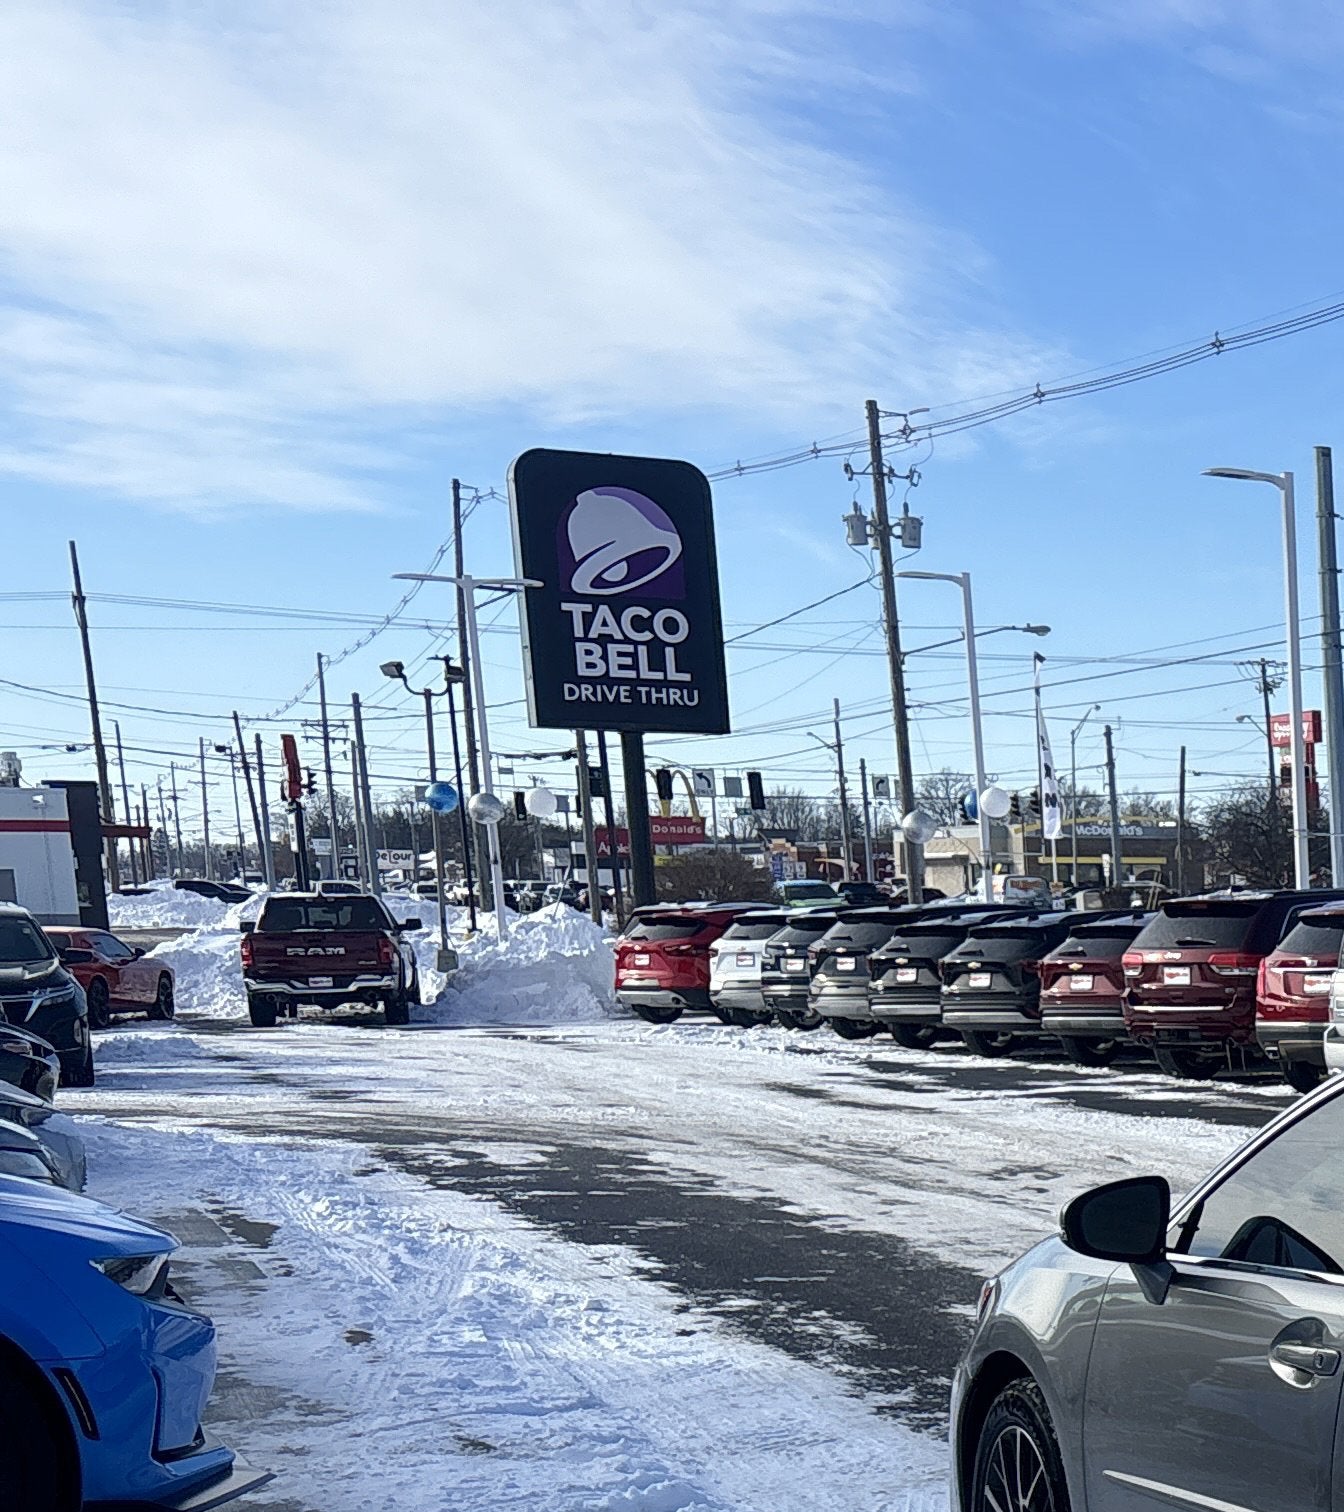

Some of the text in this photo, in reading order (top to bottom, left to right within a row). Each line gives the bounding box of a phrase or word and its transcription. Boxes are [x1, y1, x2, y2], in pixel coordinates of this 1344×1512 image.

[560, 602, 690, 644] TACO
[575, 641, 692, 682] BELL
[563, 683, 700, 707] DRIVE THRU
[286, 946, 346, 956] RAM
